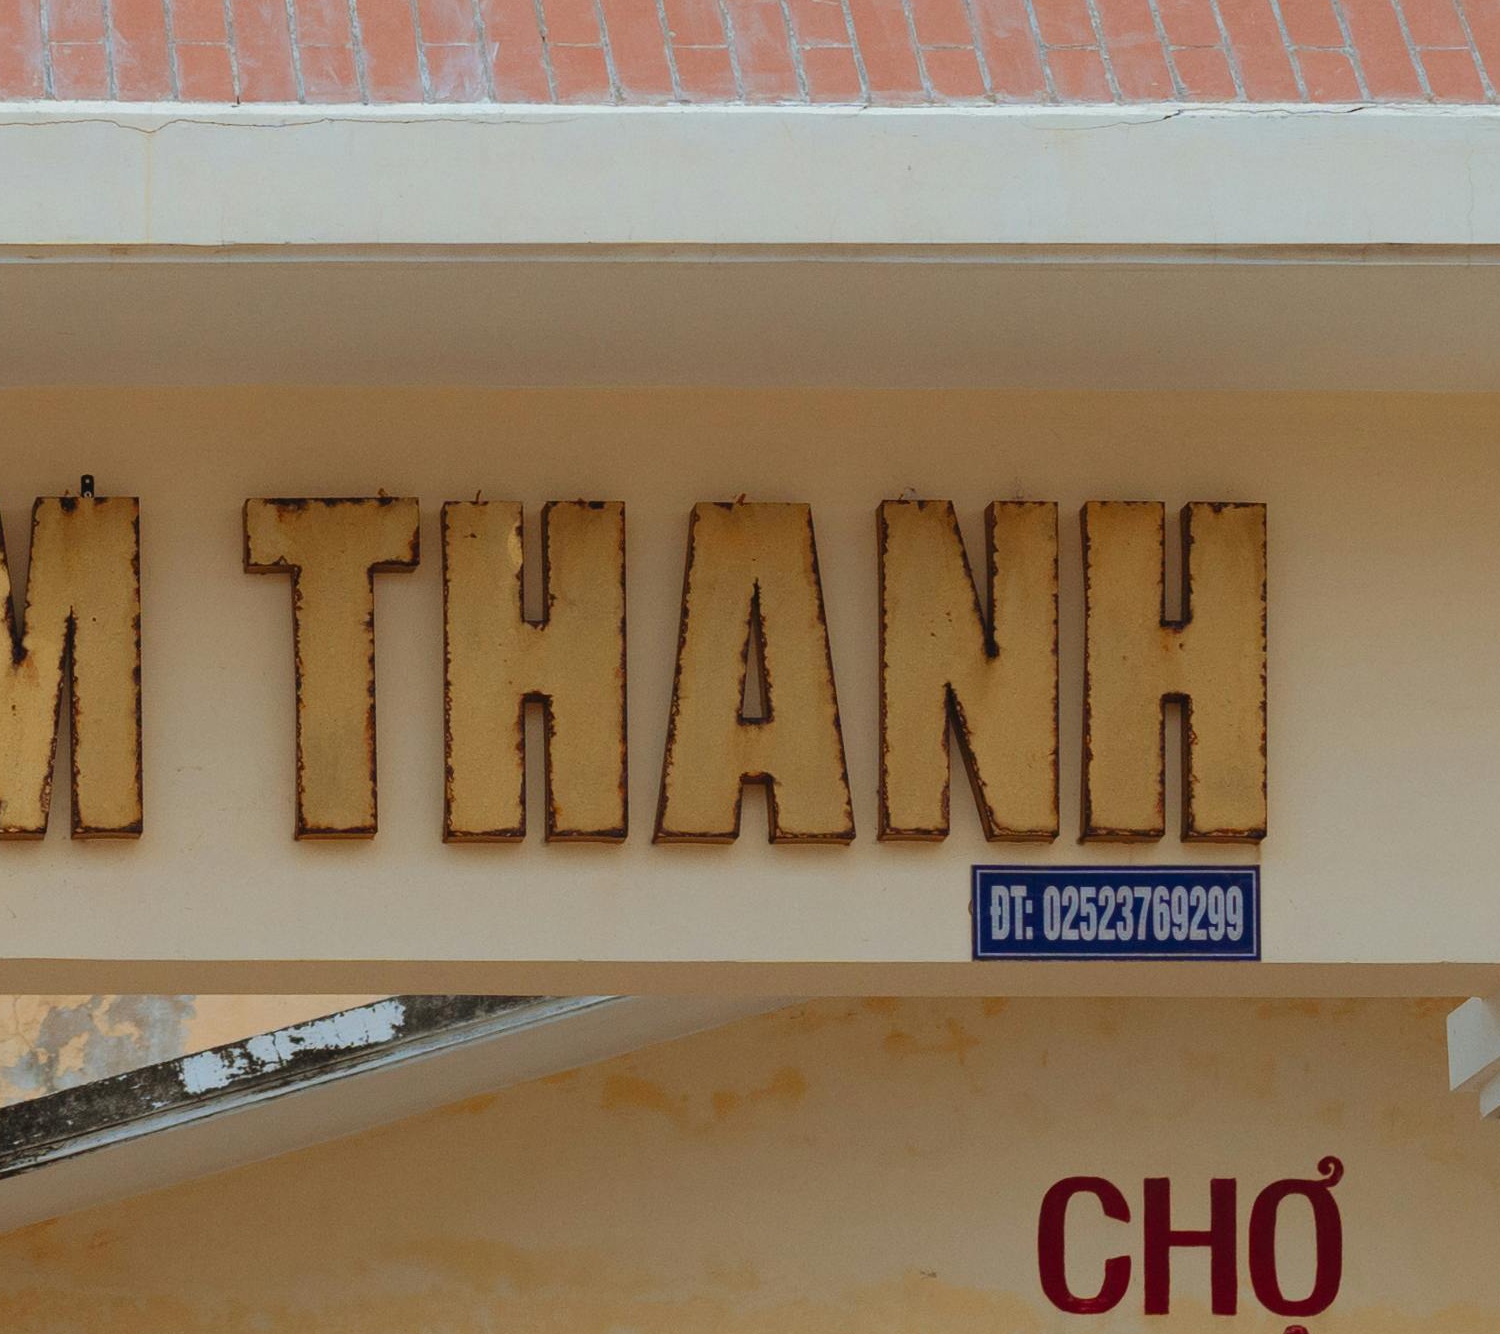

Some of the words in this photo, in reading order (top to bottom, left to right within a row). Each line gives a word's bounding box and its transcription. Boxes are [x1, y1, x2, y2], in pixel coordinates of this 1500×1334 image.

[243, 497, 1267, 844] THANH
[990, 885, 1033, 940] ĐT:
[1043, 885, 1244, 941] 02523769299
